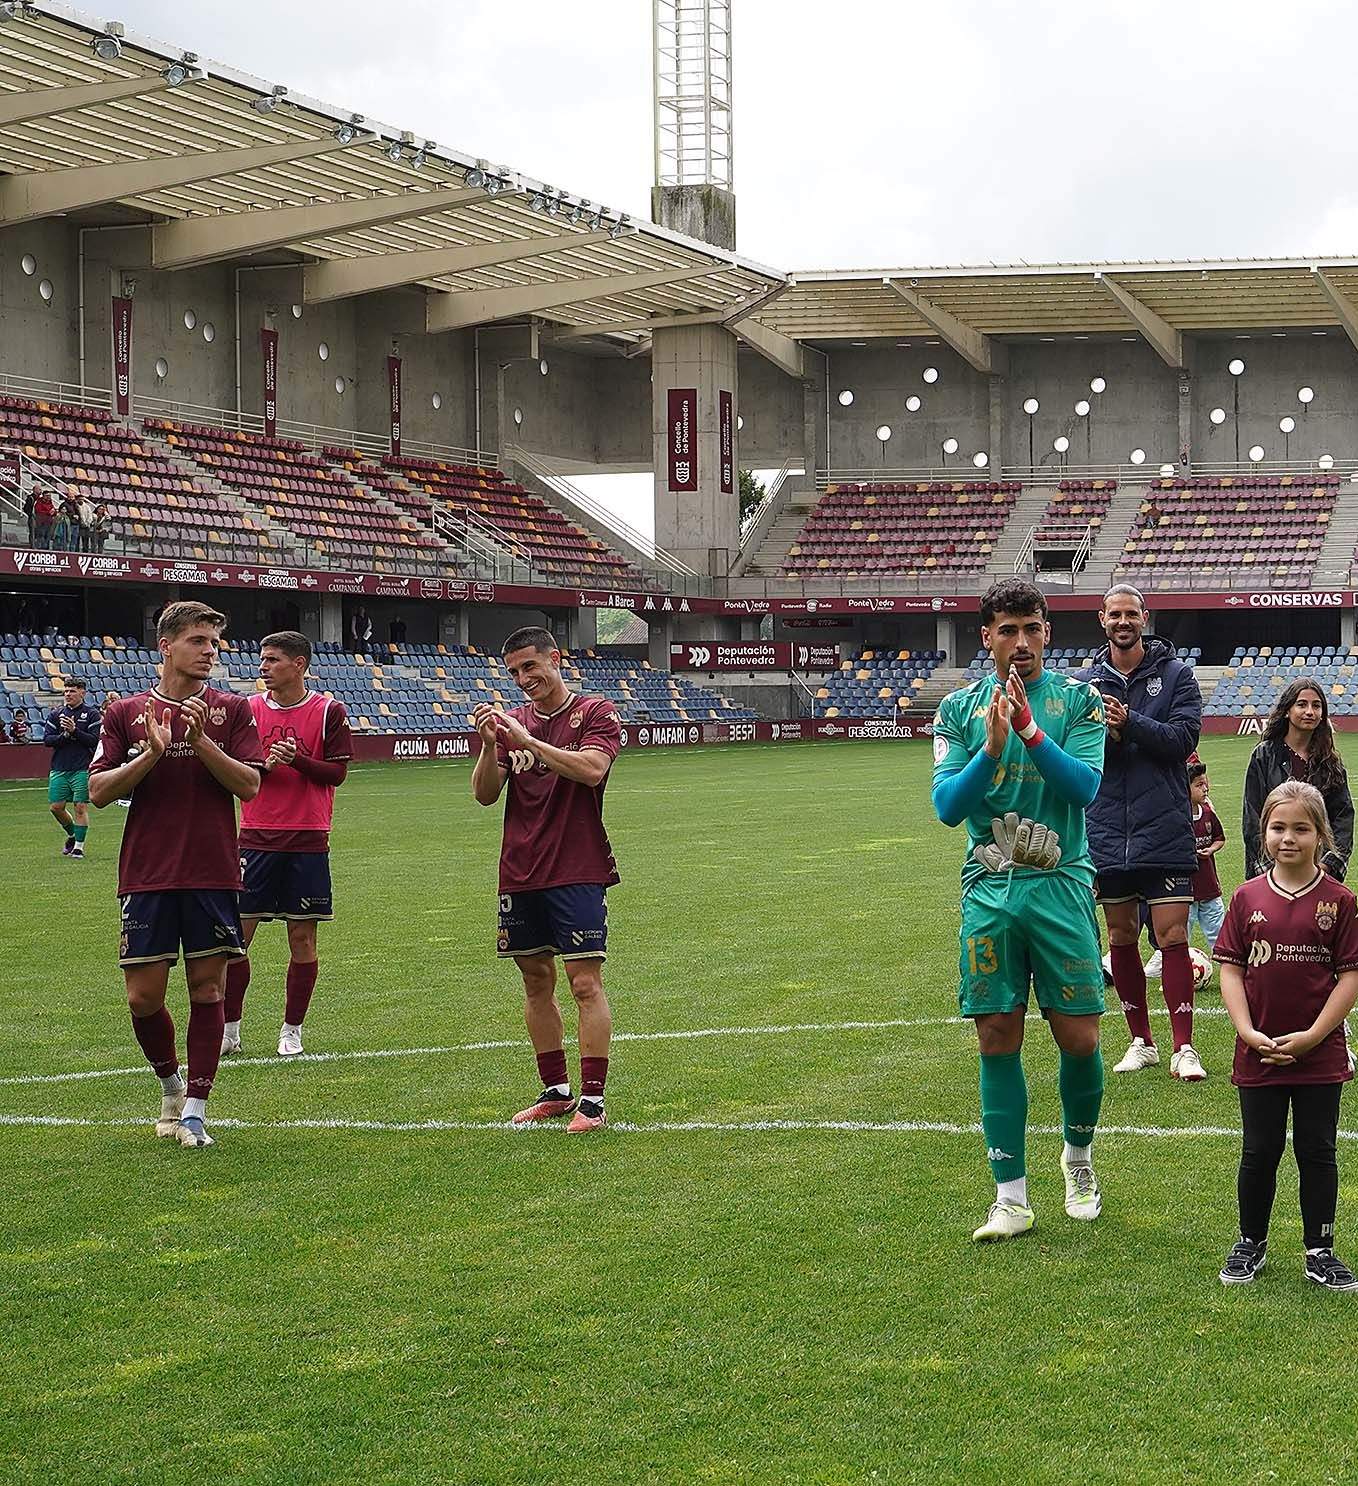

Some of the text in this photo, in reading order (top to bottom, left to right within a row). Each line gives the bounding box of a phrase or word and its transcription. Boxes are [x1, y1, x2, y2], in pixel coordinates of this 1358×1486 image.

[682, 443, 689, 454] de
[29, 553, 57, 565] CORBA
[92, 557, 119, 569] CORBA
[163, 570, 208, 583] PESCAMAR
[258, 574, 298, 589] PESCAMAR
[609, 594, 614, 606] A
[1250, 593, 1343, 607] CONSERVAS
[718, 646, 775, 659] Deputación
[811, 647, 833, 656] Deputación
[718, 656, 775, 665] Pontevedra
[652, 727, 686, 745] MAFARI
[848, 727, 912, 738] PESCAMAR
[393, 736, 470, 755] ACUÑA ACUÑA
[1276, 943, 1333, 954] Deputación
[967, 936, 998, 975] 13
[1276, 953, 1331, 963] Pontevedra
